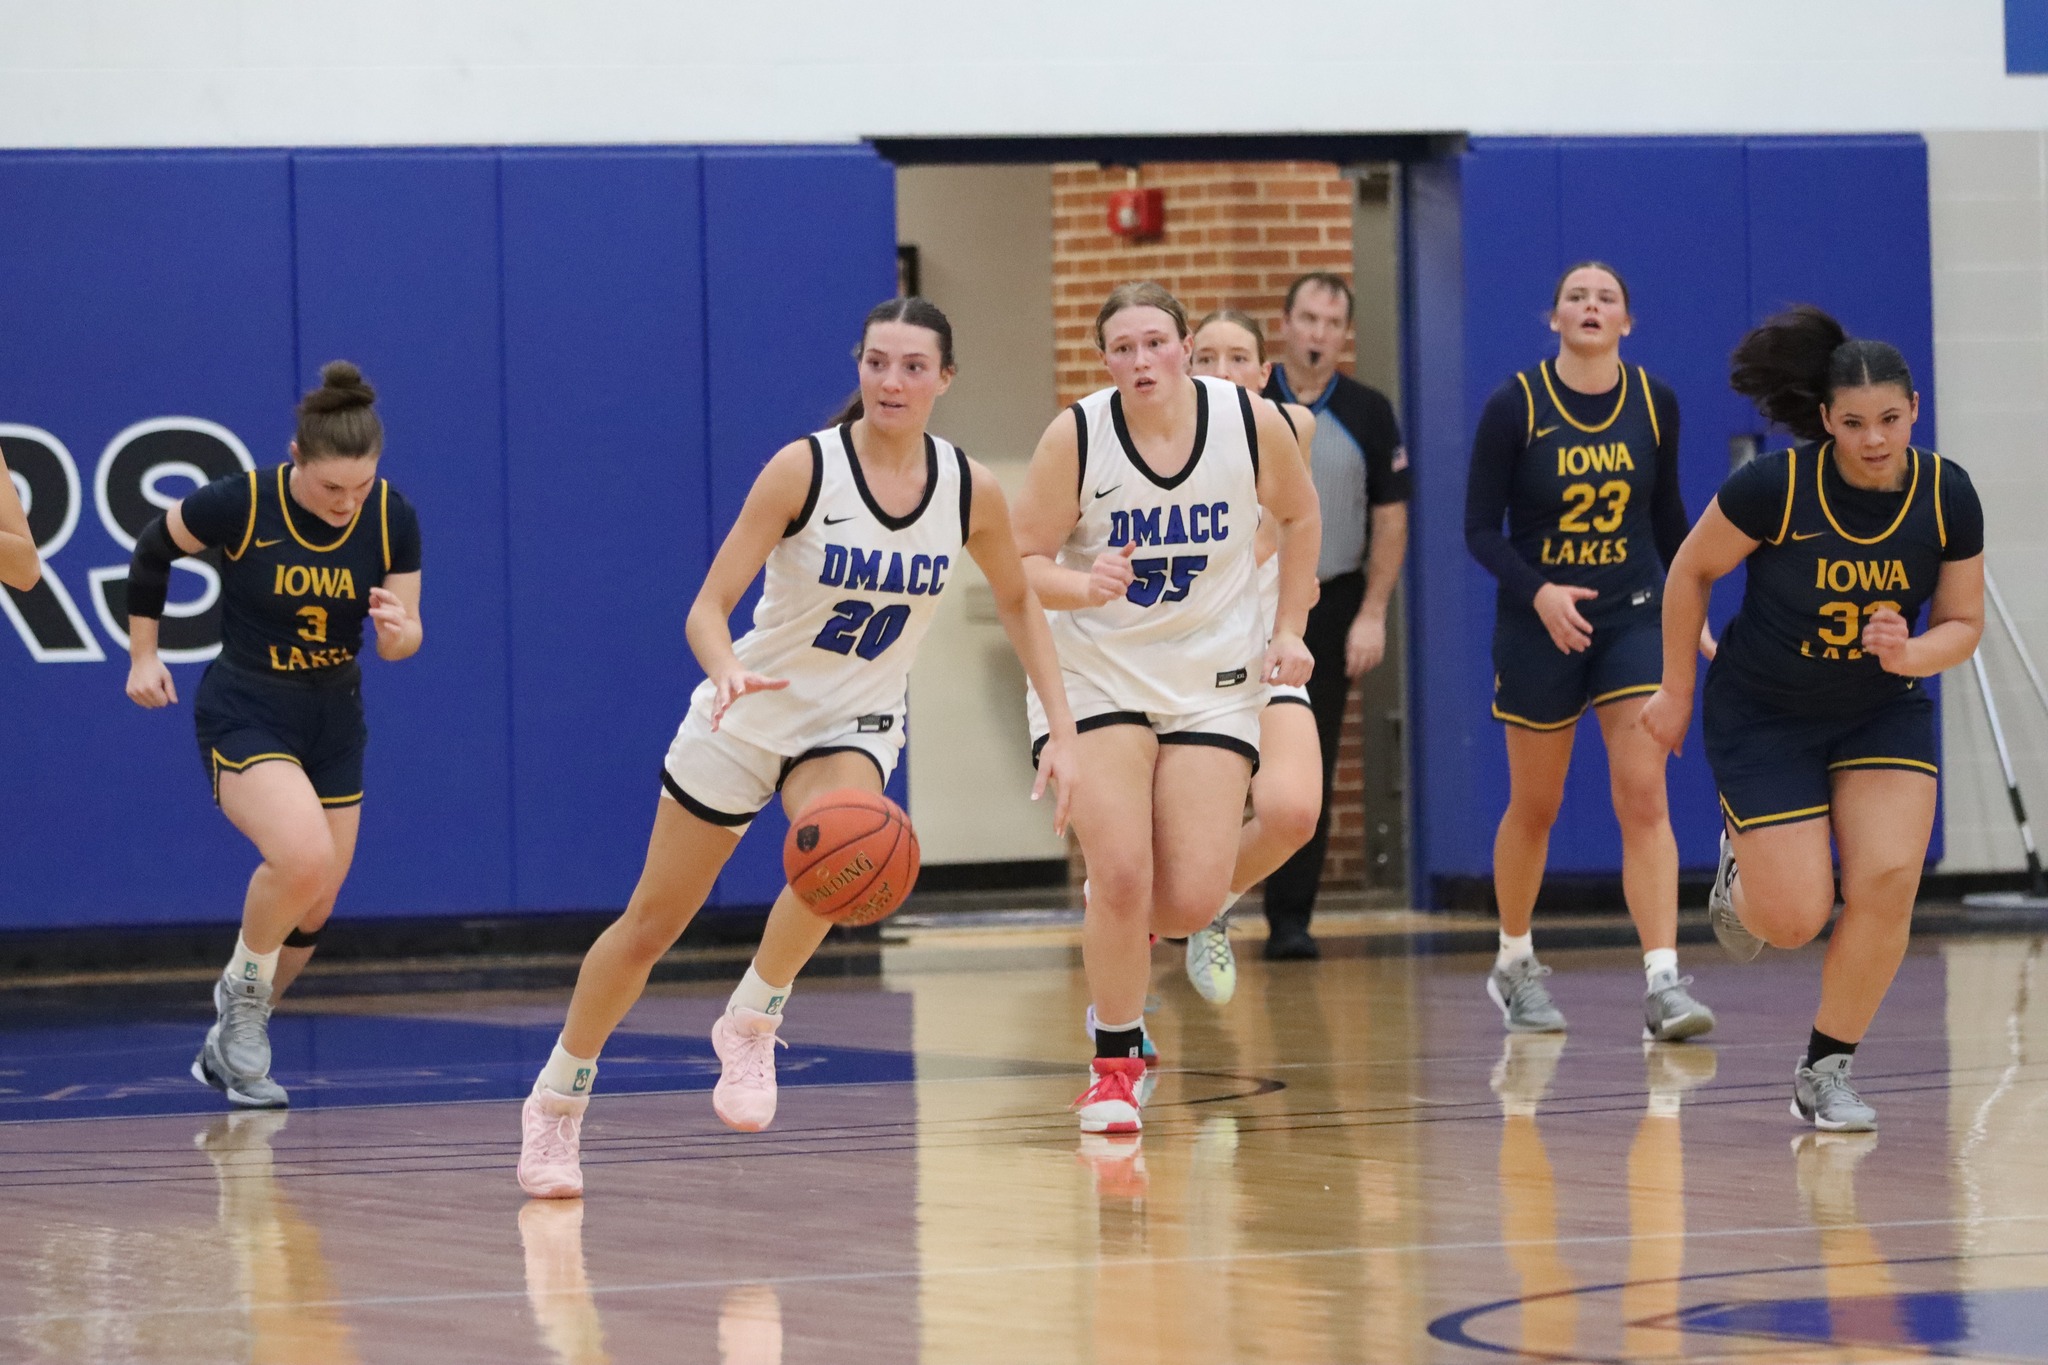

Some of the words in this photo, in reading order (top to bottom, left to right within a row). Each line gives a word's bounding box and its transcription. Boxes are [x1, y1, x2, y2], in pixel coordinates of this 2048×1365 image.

[1557, 442, 1635, 476] IOWA
[1108, 501, 1229, 547] DMACC
[1559, 480, 1631, 533] 23
[818, 543, 949, 596] DMACC
[1541, 537, 1628, 565] LAKES
[274, 564, 357, 600] IOWA
[1125, 554, 1208, 608] 55
[1815, 558, 1911, 593] IOWA
[295, 605, 328, 643] 3
[811, 599, 911, 662] 20
[882, 719, 890, 728] M
[801, 851, 874, 906] PALDING
